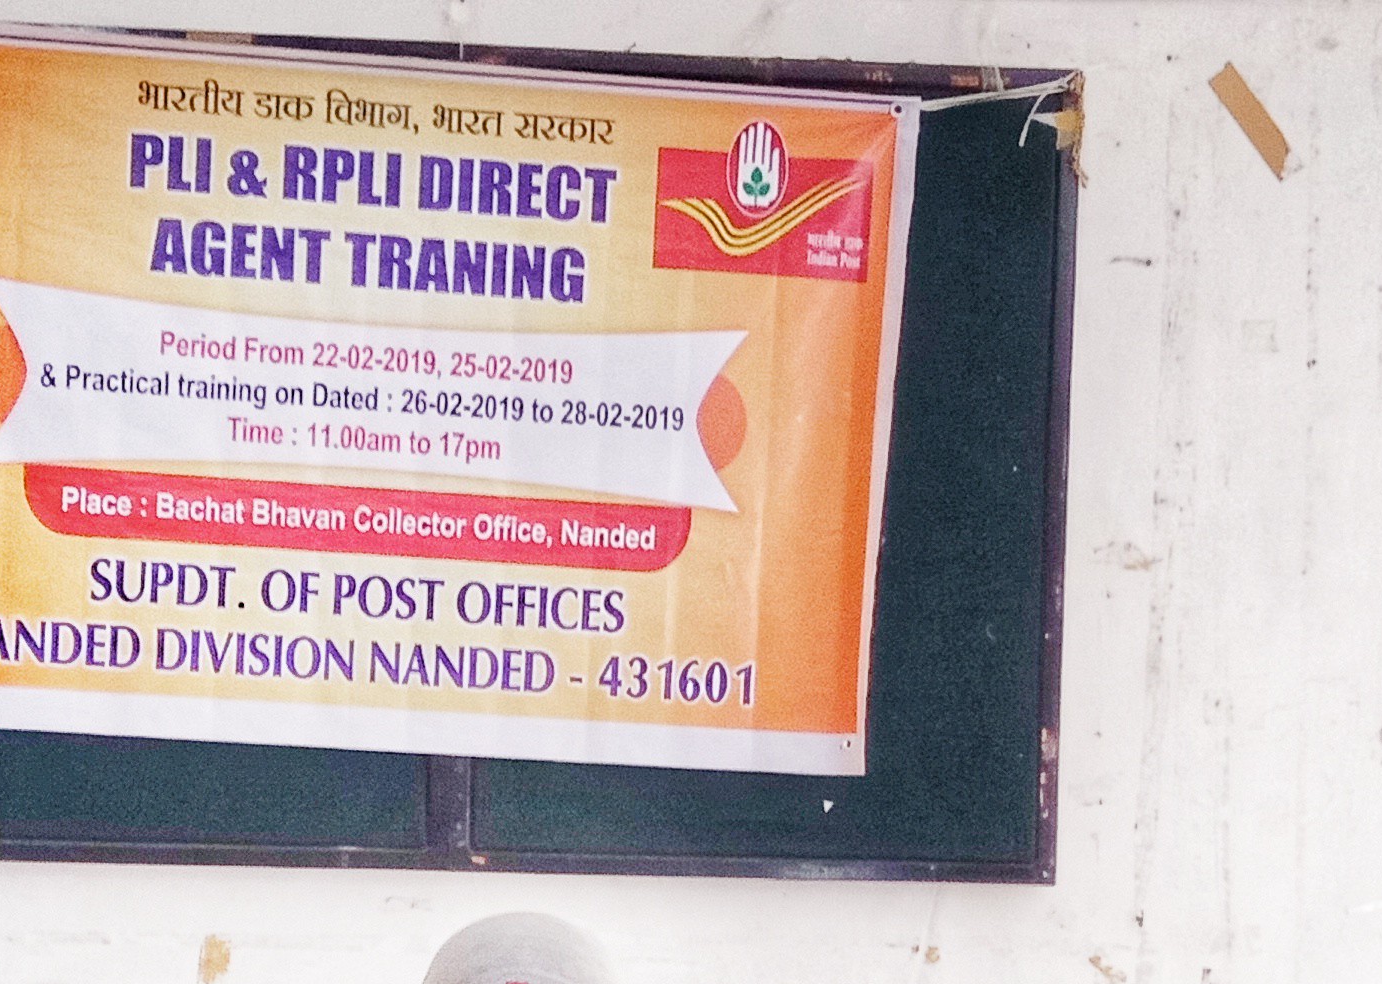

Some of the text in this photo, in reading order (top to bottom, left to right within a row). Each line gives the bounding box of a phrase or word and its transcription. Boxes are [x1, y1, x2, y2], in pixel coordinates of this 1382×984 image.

[138, 78, 615, 146] भारतीय डाक विभाग, भारत सरकार
[130, 133, 617, 223] PLI & RPLI DIRECT
[150, 218, 585, 303] AGENT TRANING
[160, 330, 573, 385] Period From 22-02-2019, 25-02-2019
[40, 363, 56, 388] &
[65, 364, 169, 397] Practical
[178, 374, 267, 409] training
[275, 387, 304, 406] on
[313, 382, 379, 411] Dated
[401, 389, 524, 422] 26-02-2019
[532, 399, 553, 423] to
[560, 400, 684, 431] 28-02-2019
[228, 416, 283, 445] Time
[307, 424, 401, 454] 11.00am
[409, 431, 431, 455] to
[439, 432, 501, 464] 17pm
[61, 486, 132, 518] Place
[155, 492, 246, 525] Bachat
[252, 498, 346, 531] Bhavan
[353, 505, 467, 538] Collector
[473, 513, 553, 548] Office,
[560, 520, 656, 551] Nanded
[90, 558, 625, 632] SUPDT. OF POST OFFICES
[155, 627, 355, 681] DIVISION
[369, 640, 555, 692] NANDED
[598, 656, 757, 706] 431601
